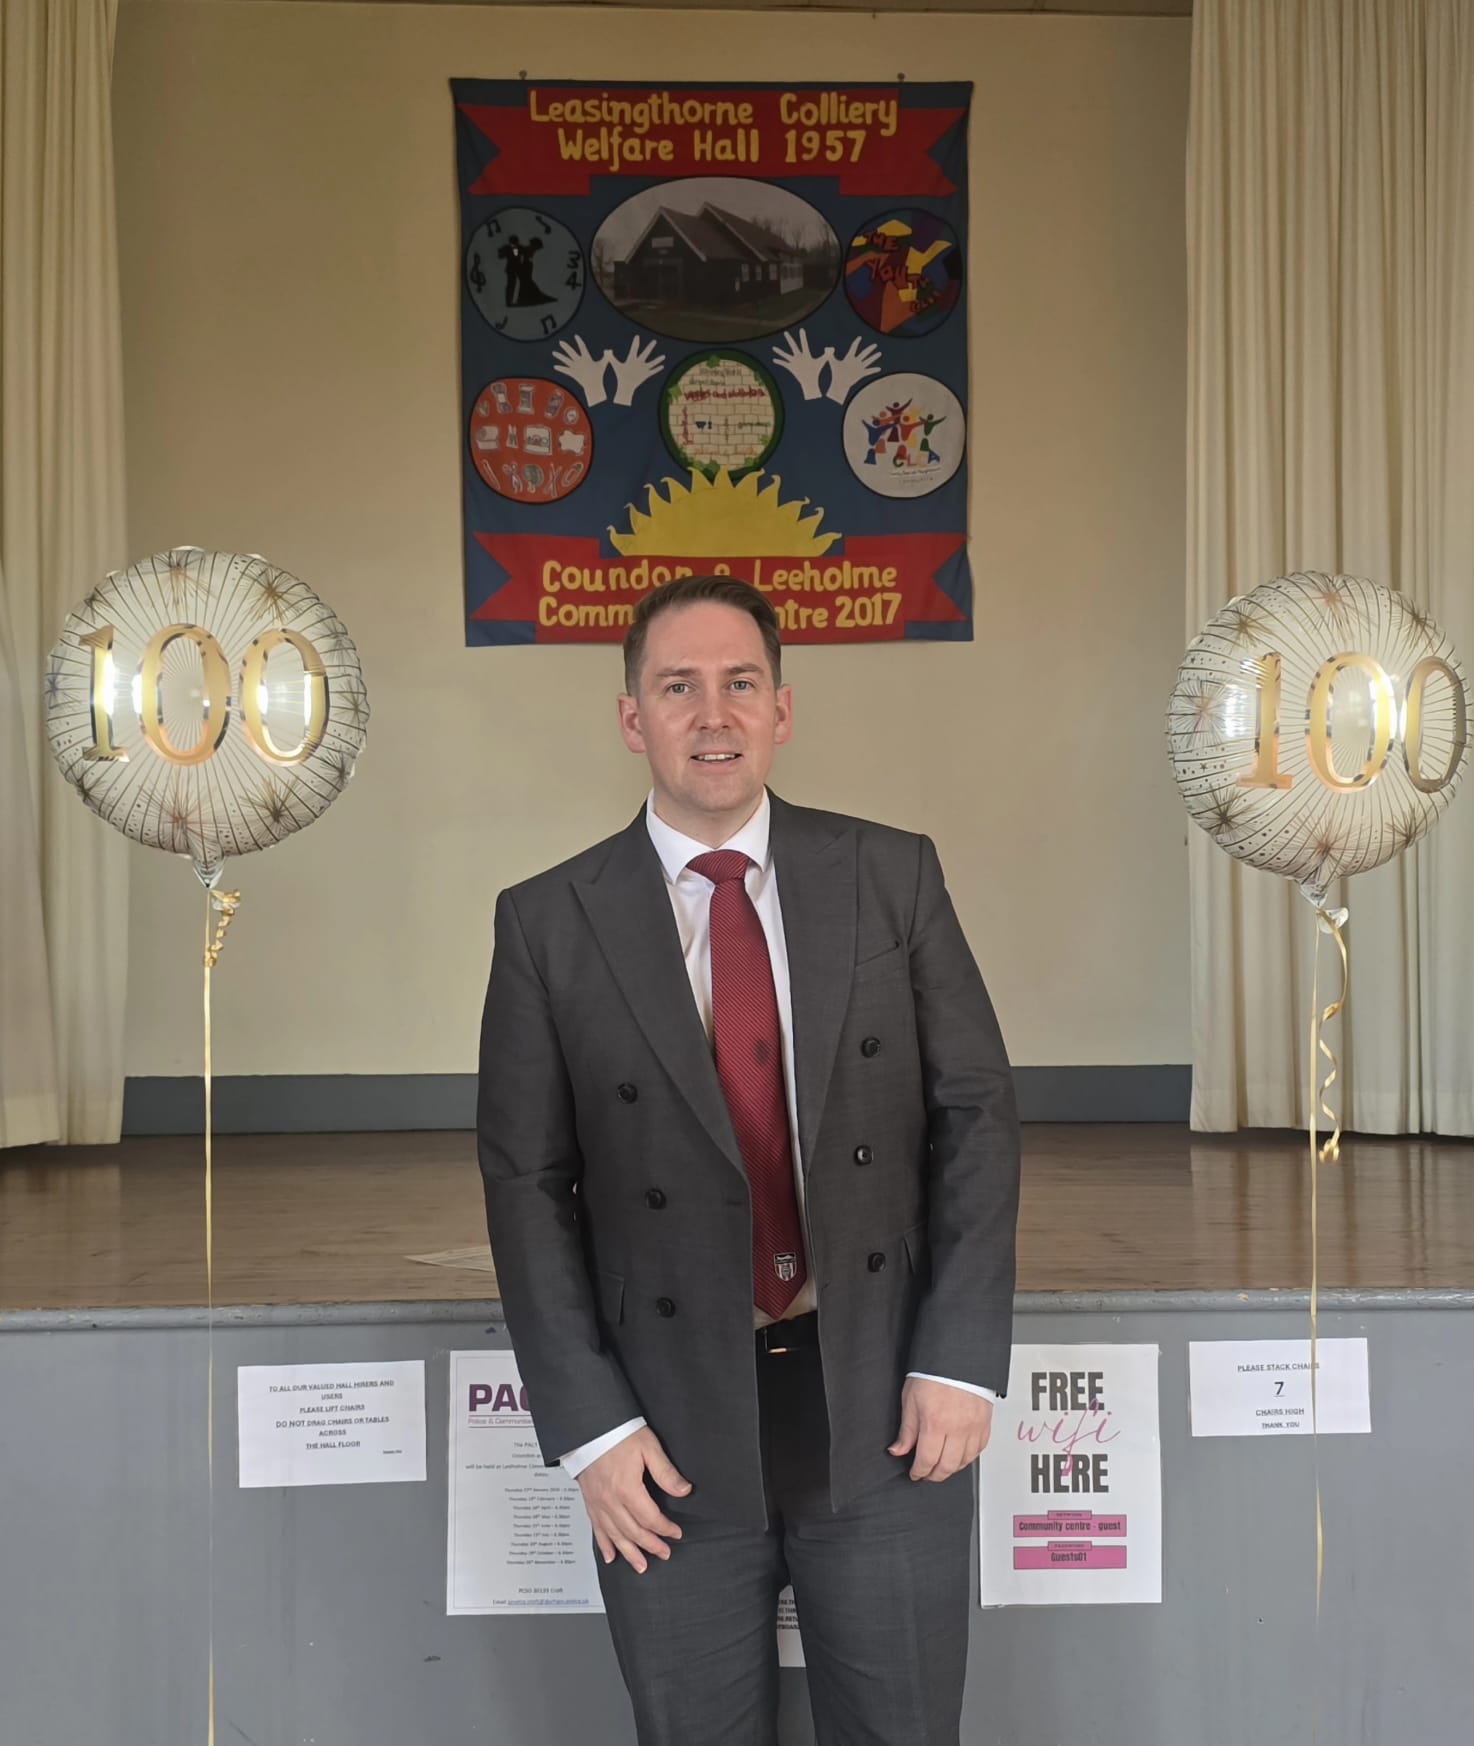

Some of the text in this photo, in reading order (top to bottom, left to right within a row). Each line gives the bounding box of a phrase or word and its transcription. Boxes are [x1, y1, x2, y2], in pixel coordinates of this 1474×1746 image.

[530, 90, 897, 136] Leasingthorne Colliery
[557, 126, 866, 172] Welfare Hall 1957
[753, 559, 897, 592] Leeholme
[835, 592, 902, 628] 2017
[79, 623, 330, 766] 100
[1237, 652, 1467, 793] 100
[1237, 1362, 1320, 1372] PLEASE STACK CHAIS
[308, 1383, 335, 1391] VALUED
[1031, 1372, 1105, 1411] FREE
[1274, 1381, 1285, 1396] 7
[299, 1406, 324, 1414] PLEASE
[340, 1404, 365, 1412] CHAIRS
[1255, 1408, 1304, 1417] CHAIRS HIGH
[288, 1420, 305, 1428] NOT
[307, 1419, 326, 1427] DRAG
[327, 1418, 353, 1426] CHAIRS
[365, 1416, 390, 1424] TABLES
[318, 1429, 347, 1437] ACROSS
[306, 1440, 361, 1450] THE HALL FLOOR
[1017, 1397, 1121, 1476] wifi
[1031, 1454, 1109, 1493] HERE
[1019, 1522, 1063, 1532] Community
[1065, 1521, 1091, 1531] centre
[1098, 1521, 1121, 1531] guest
